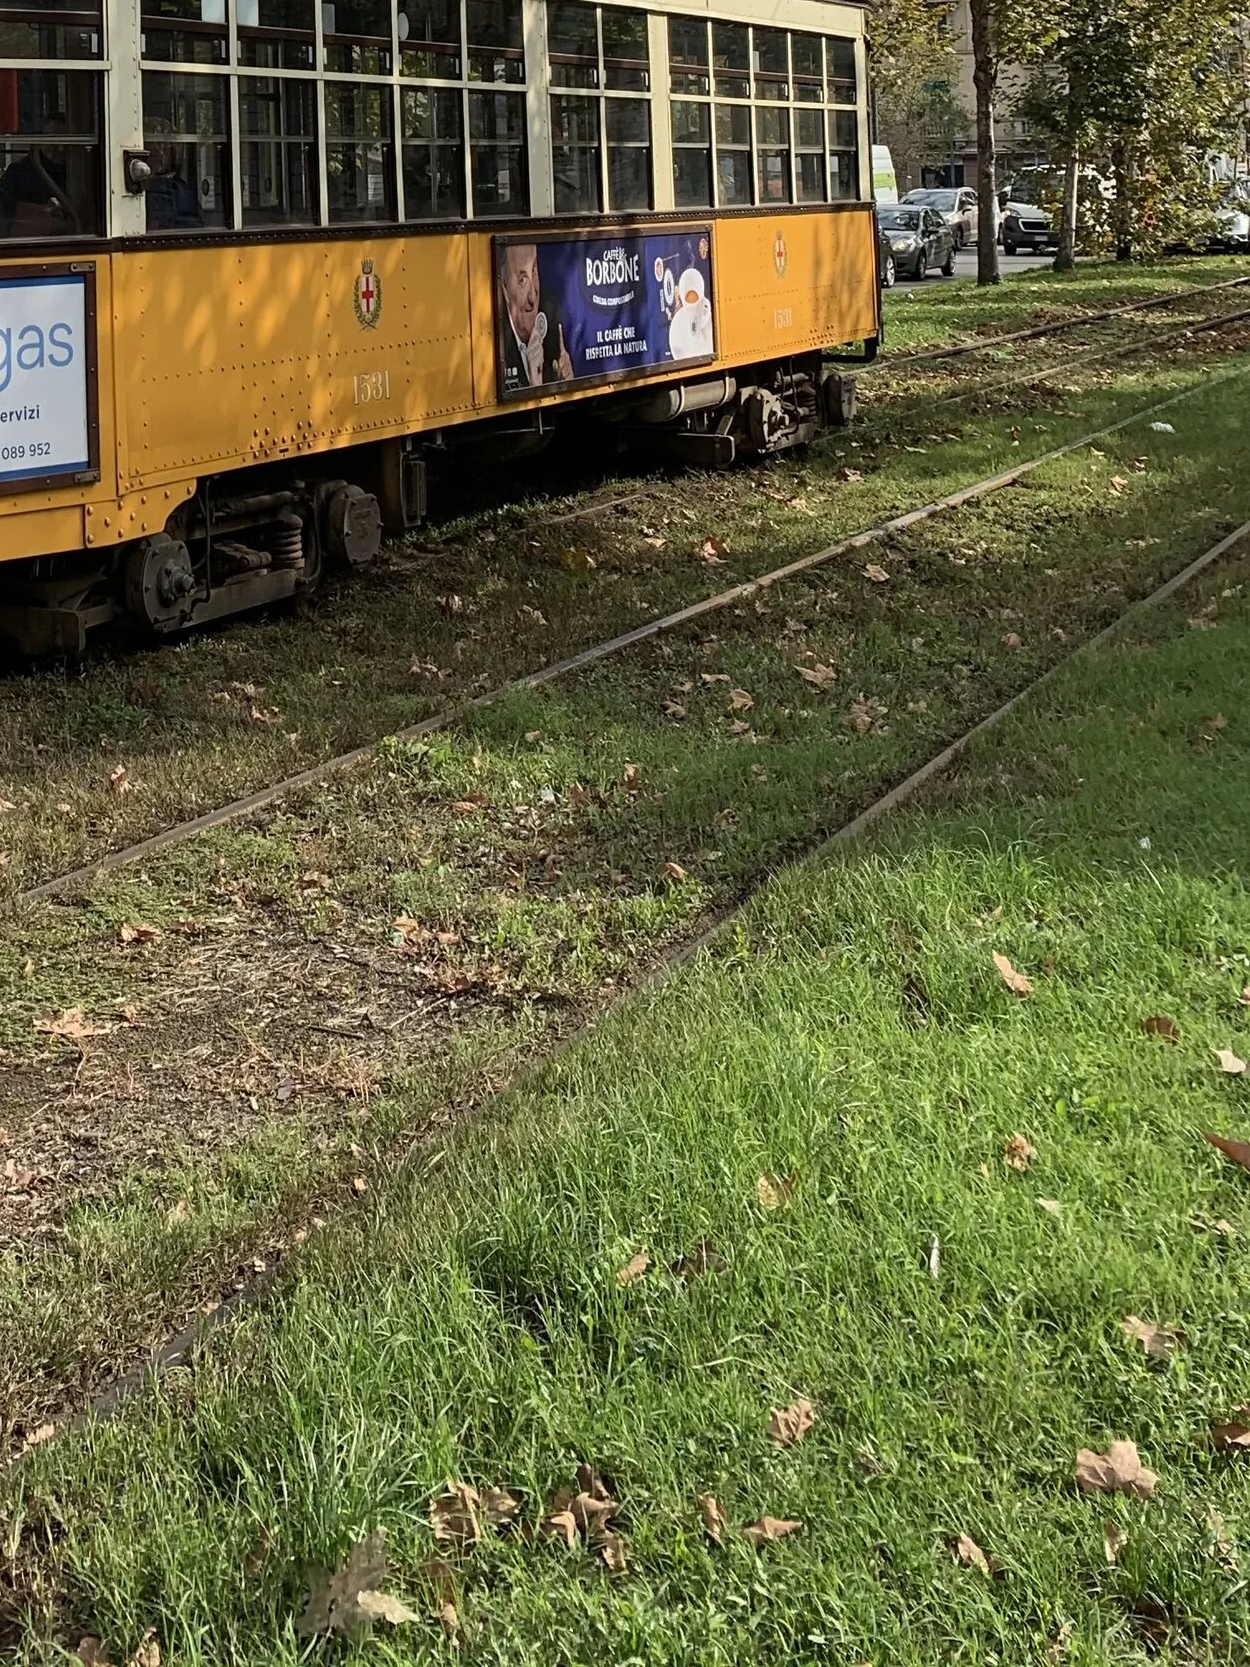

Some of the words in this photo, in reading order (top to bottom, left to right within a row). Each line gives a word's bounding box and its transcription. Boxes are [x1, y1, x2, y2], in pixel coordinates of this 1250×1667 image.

[586, 254, 640, 286] BORBONE
[773, 307, 792, 330] 1531
[596, 330, 603, 343] IL
[604, 324, 622, 342] CAFFÈ
[623, 326, 636, 339] CHE
[585, 344, 613, 361] RISPETTA
[614, 342, 623, 356] LA
[623, 339, 648, 355] NATURA
[353, 370, 391, 405] 1531
[1, 445, 25, 461] 089
[29, 442, 51, 457] 952
